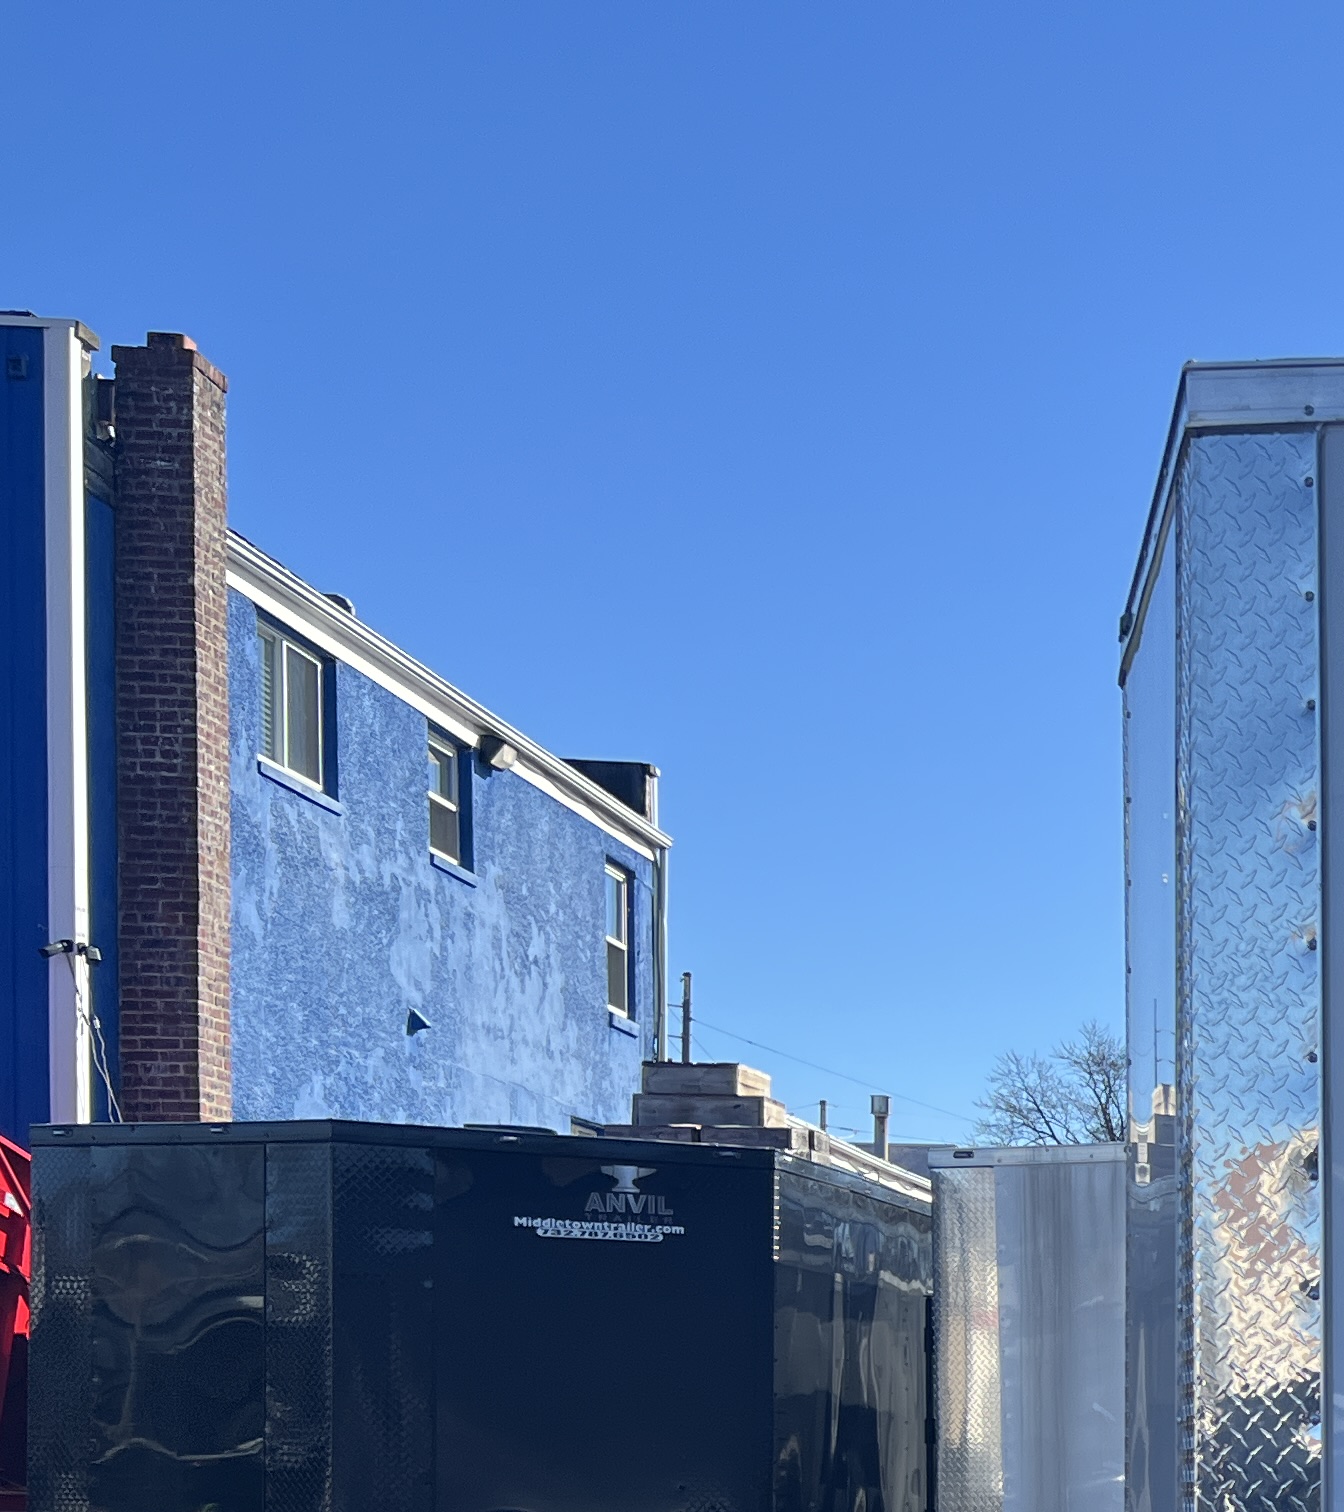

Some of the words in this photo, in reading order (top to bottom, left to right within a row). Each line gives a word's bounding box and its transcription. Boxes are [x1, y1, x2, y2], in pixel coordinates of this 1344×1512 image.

[584, 1192, 673, 1215] ANVIL
[514, 1216, 685, 1235] Middletowntrailer.com
[585, 1213, 673, 1225] TRAILER
